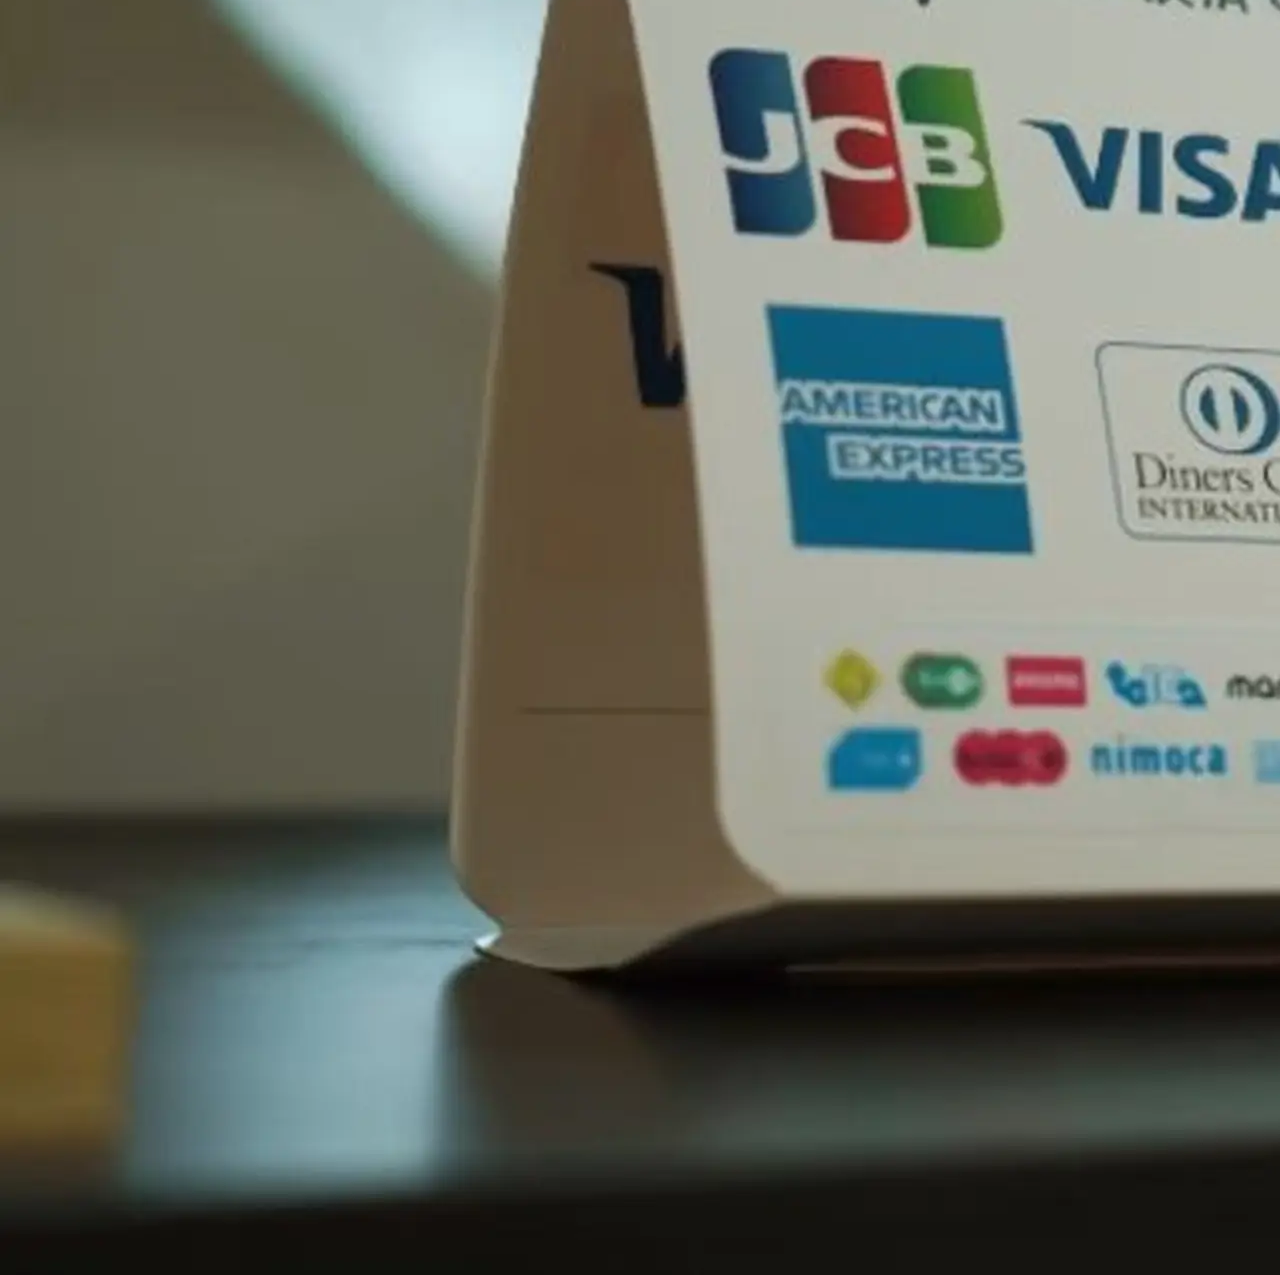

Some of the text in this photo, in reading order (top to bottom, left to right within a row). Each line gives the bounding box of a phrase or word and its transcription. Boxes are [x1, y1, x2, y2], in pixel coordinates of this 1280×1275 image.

[780, 384, 1000, 425] AMERICAN
[833, 440, 1026, 479] EXPRESS
[1133, 452, 1256, 494] Diners
[1089, 734, 1228, 777] nimoca
